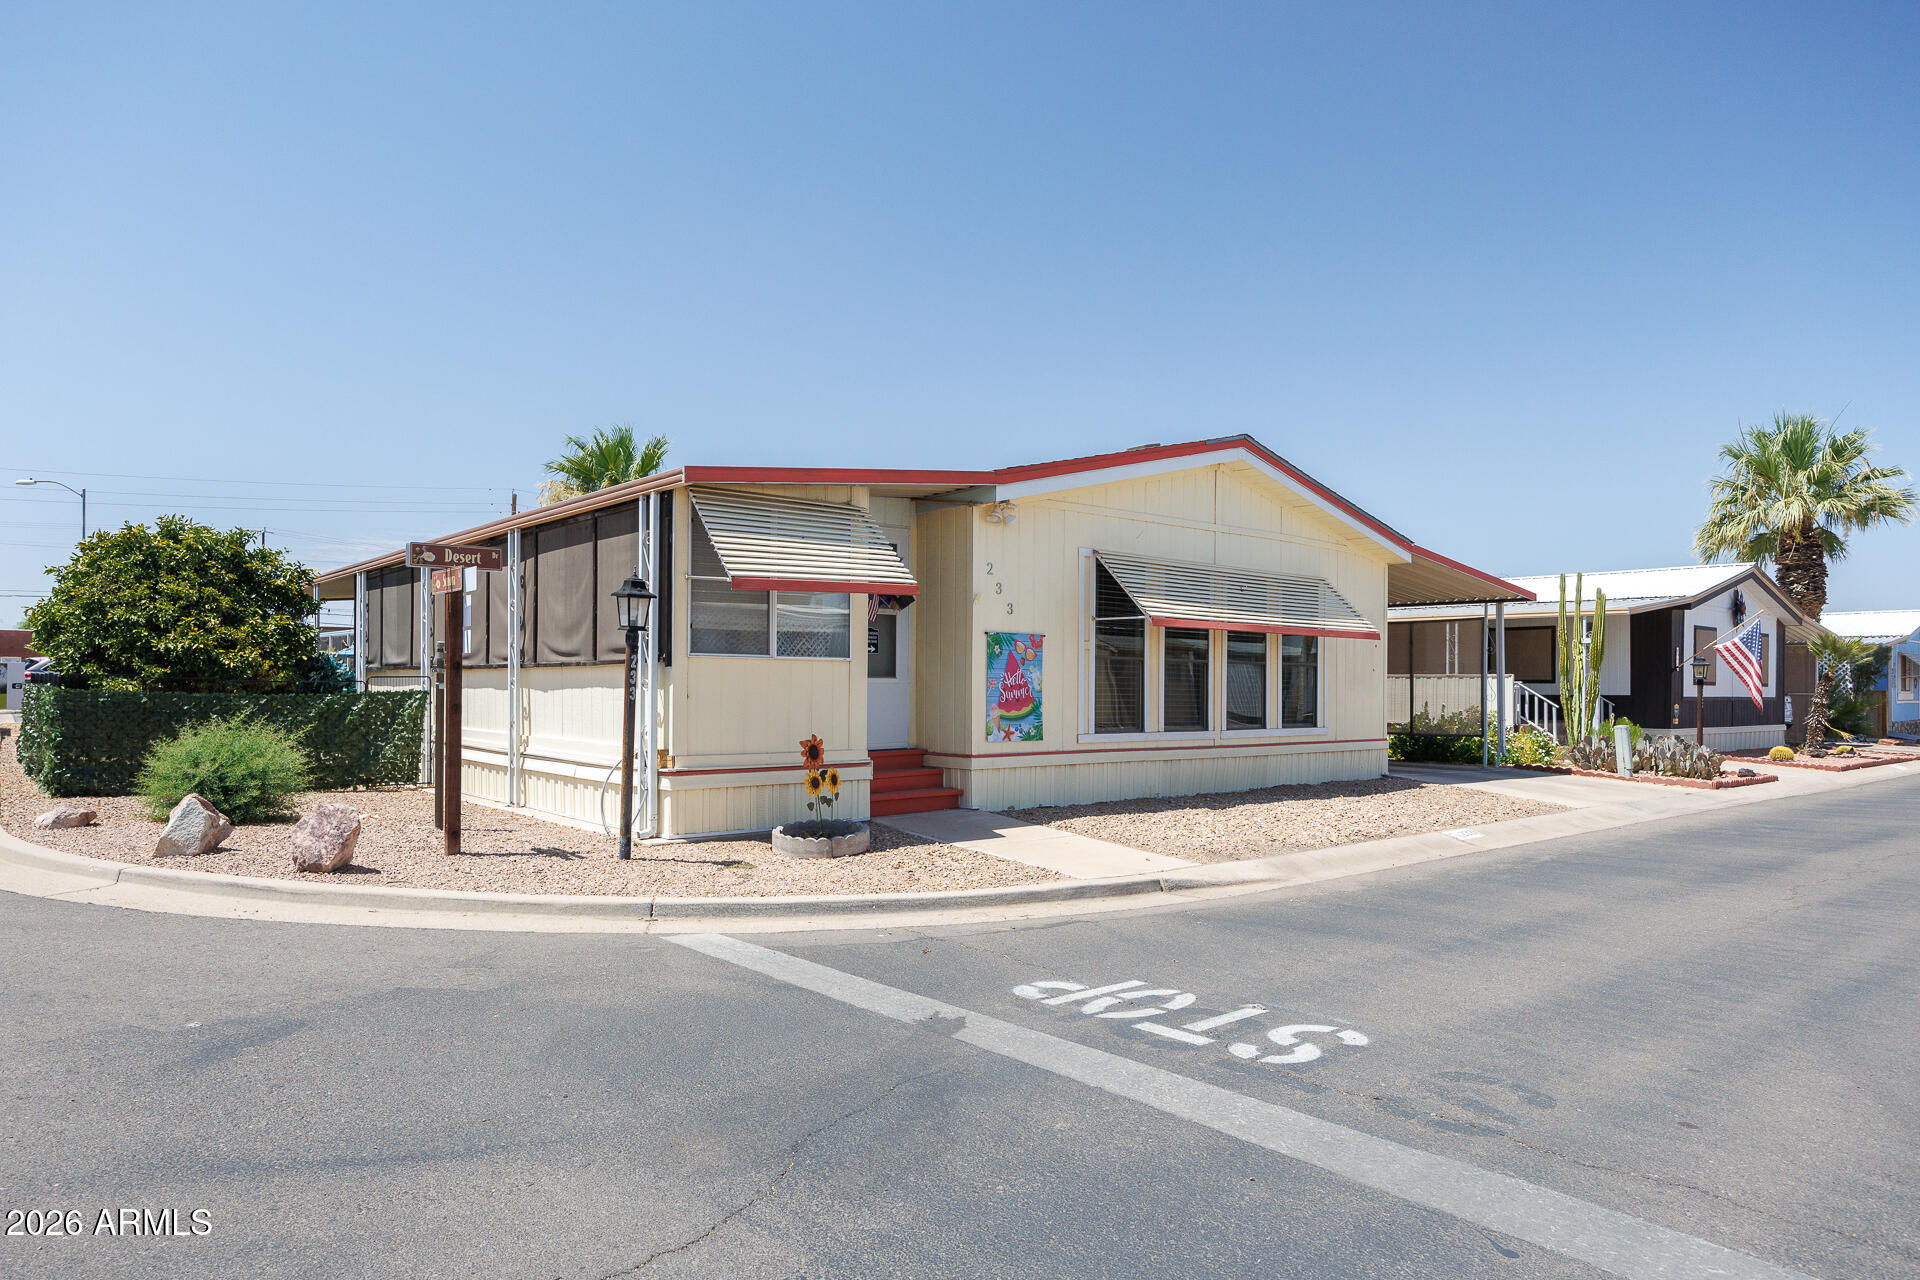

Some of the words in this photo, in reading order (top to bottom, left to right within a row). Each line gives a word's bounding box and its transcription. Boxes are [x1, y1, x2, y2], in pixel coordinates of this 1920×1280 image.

[444, 548, 482, 564] Desert
[491, 551, 499, 559] Dr
[986, 561, 1014, 616] 233
[629, 654, 637, 701] 233
[998, 681, 1033, 702] Summer
[1003, 668, 1026, 687] Hello
[1012, 980, 1370, 1064] STOP
